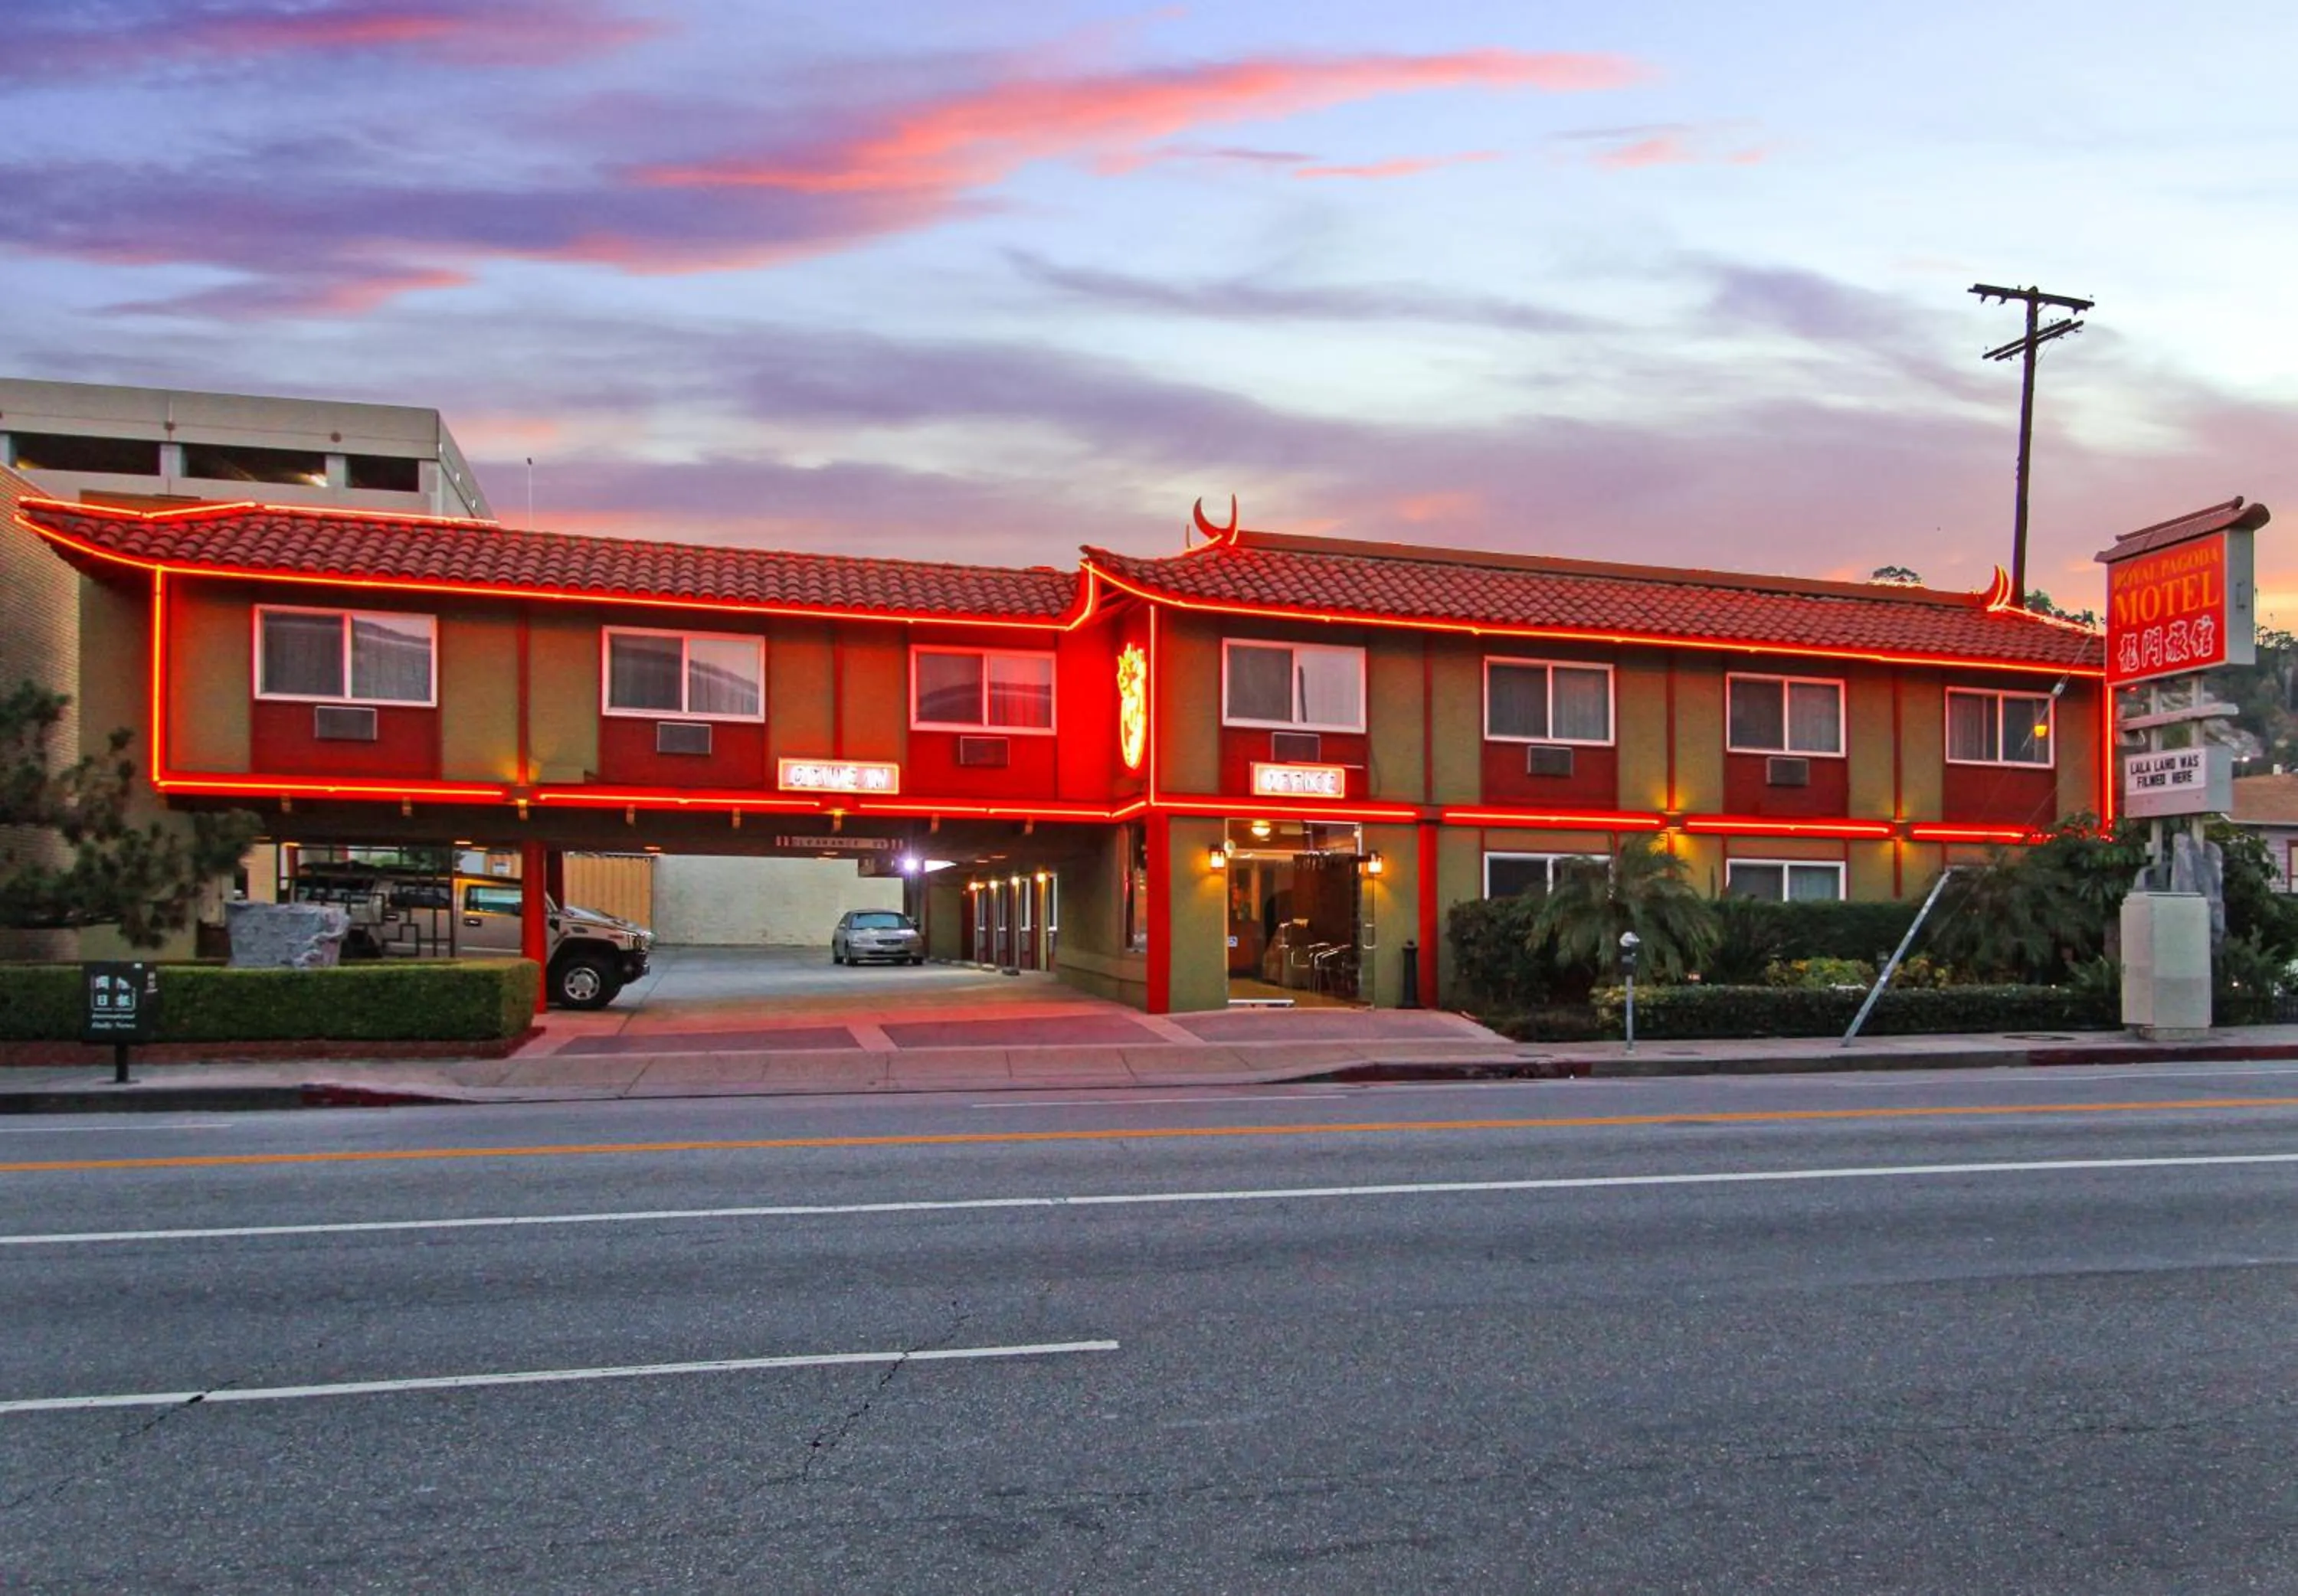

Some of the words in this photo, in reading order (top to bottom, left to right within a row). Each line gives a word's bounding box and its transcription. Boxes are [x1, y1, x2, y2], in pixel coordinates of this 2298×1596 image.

[2113, 561, 2155, 590] ROYAL
[2161, 546, 2219, 577] PAGODA
[2114, 570, 2220, 629] MOTEL
[2130, 760, 2151, 775] LALA
[2154, 757, 2176, 772] LAND
[2180, 754, 2199, 767] WAS
[2137, 773, 2165, 788] FILMED
[2172, 770, 2192, 784] HERE
